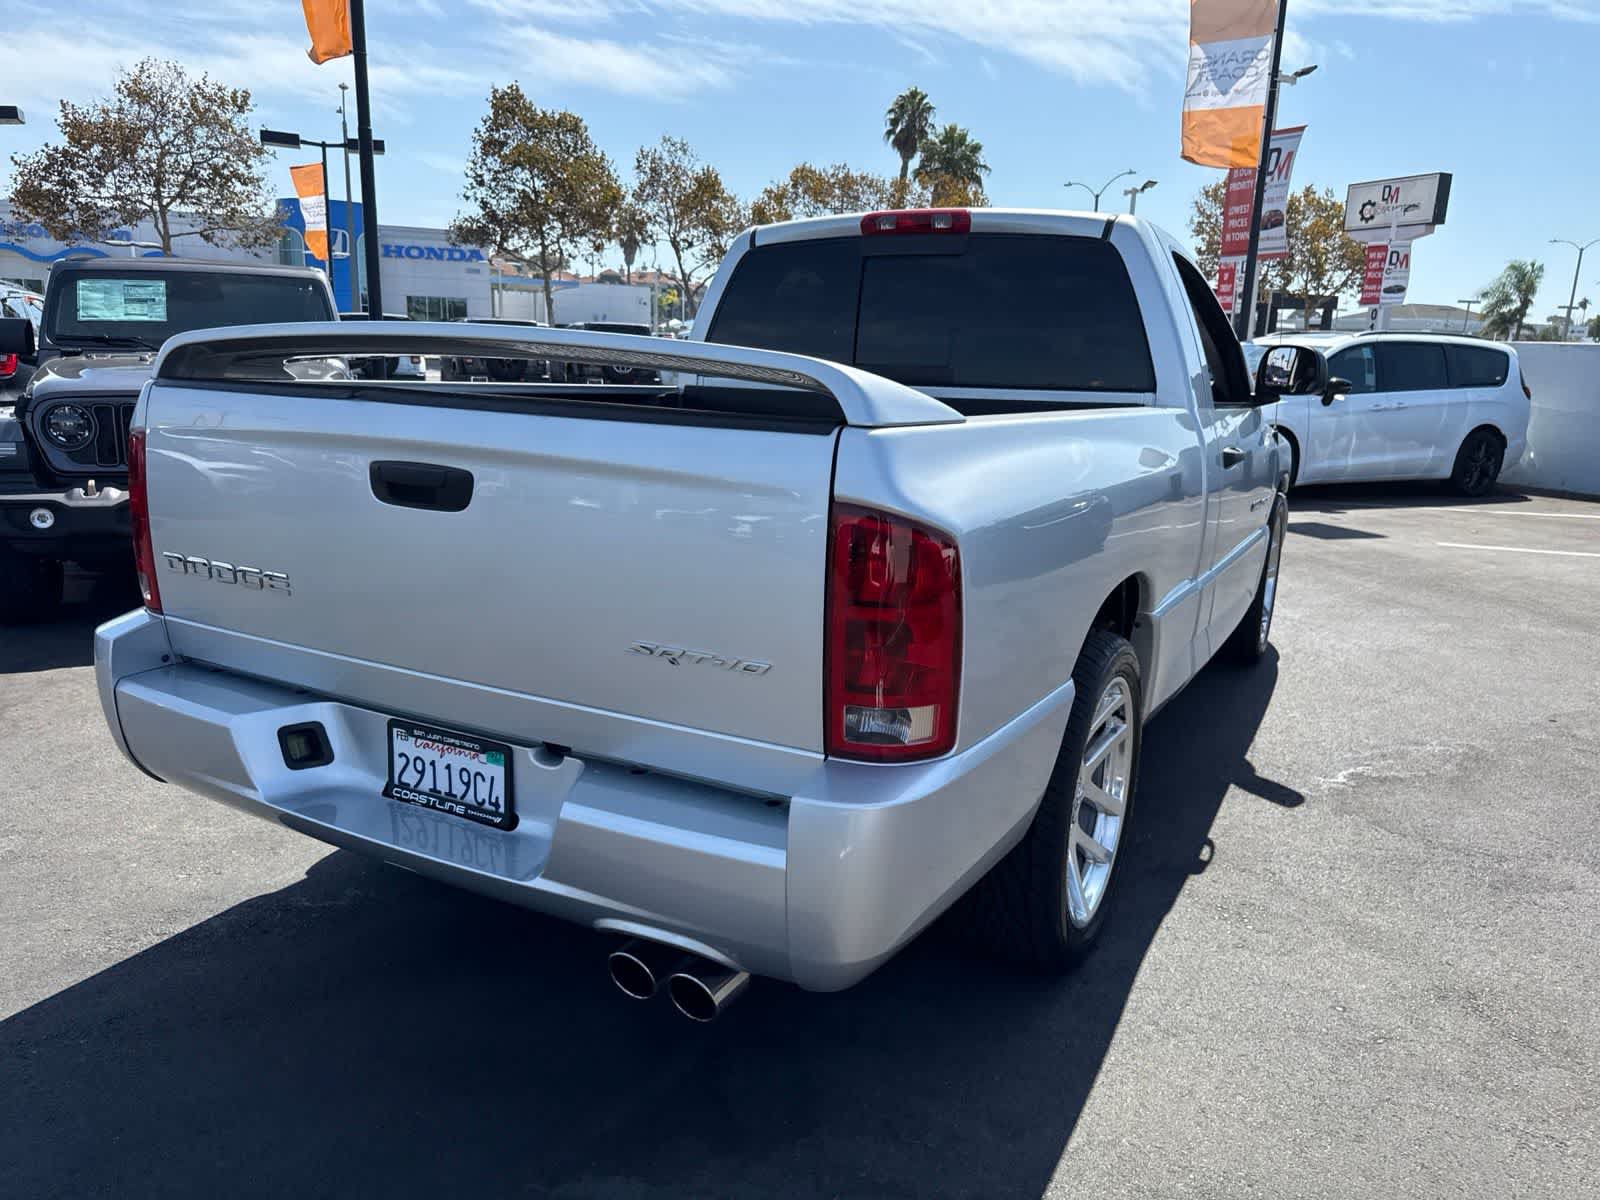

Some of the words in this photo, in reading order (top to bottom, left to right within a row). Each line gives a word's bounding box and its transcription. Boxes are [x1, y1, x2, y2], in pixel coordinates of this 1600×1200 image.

[1265, 147, 1295, 181] DM
[1381, 184, 1401, 204] DM
[383, 244, 484, 262] HONDA
[1389, 250, 1409, 270] DM
[162, 551, 292, 597] DODGE
[625, 639, 775, 676] SRT-10
[397, 752, 502, 812] 29119C4
[392, 787, 467, 815] COASTLINE
